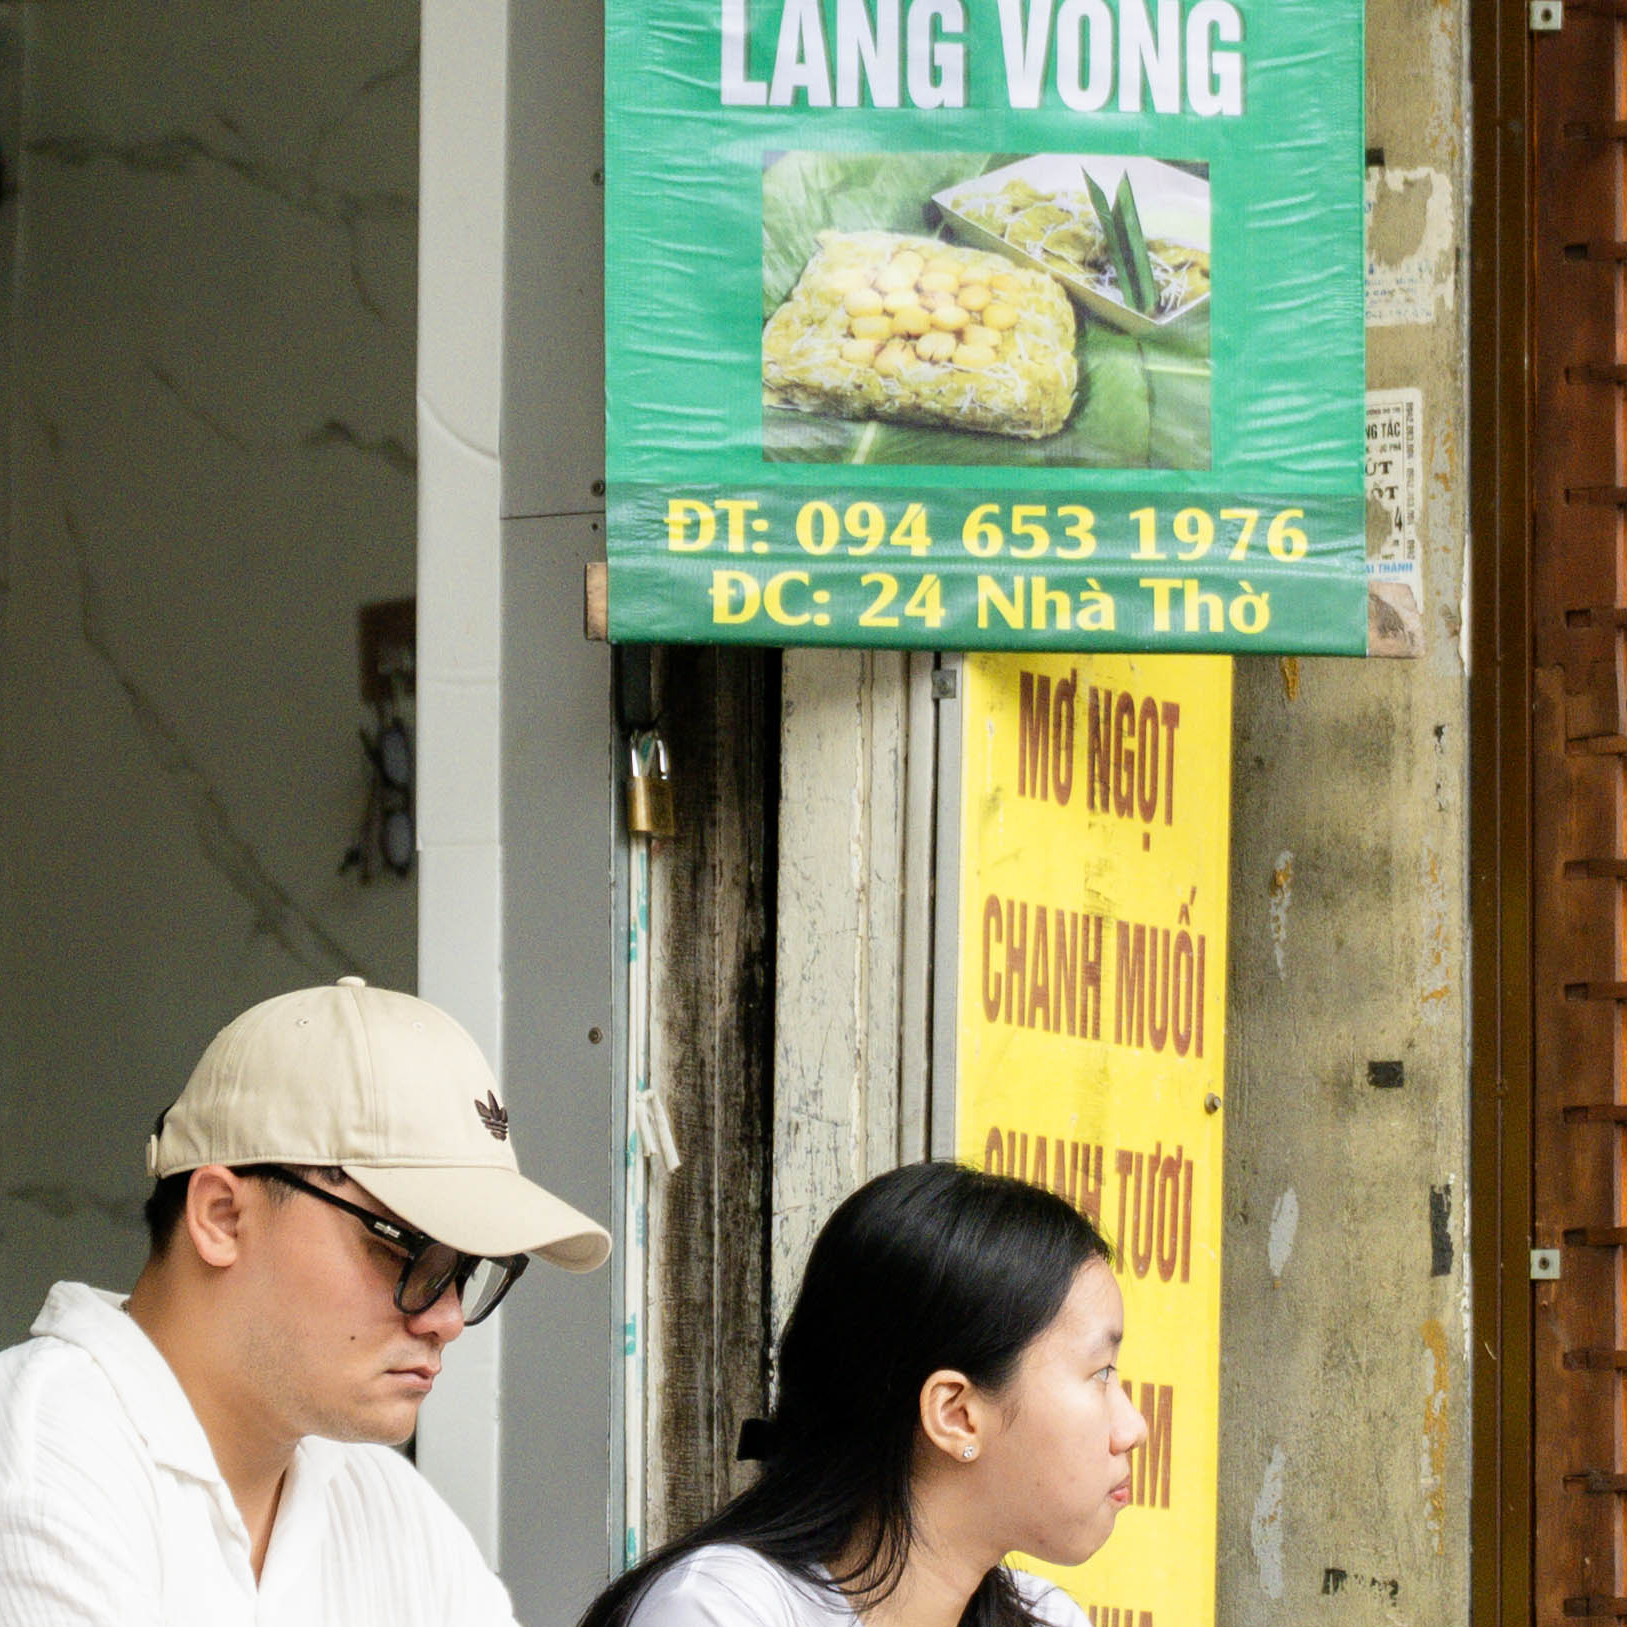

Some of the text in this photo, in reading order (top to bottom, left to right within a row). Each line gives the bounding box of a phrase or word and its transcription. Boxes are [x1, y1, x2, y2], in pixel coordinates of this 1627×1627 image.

[664, 499, 1309, 563] ĐT: 094 653 1976
[708, 570, 1271, 635] ĐC: 24 Nhà Thờ
[1017, 667, 1181, 853] MƠ NGỌT
[981, 886, 1207, 1060] CHANH MUỐI
[1114, 1140, 1194, 1284] TƯƠI
